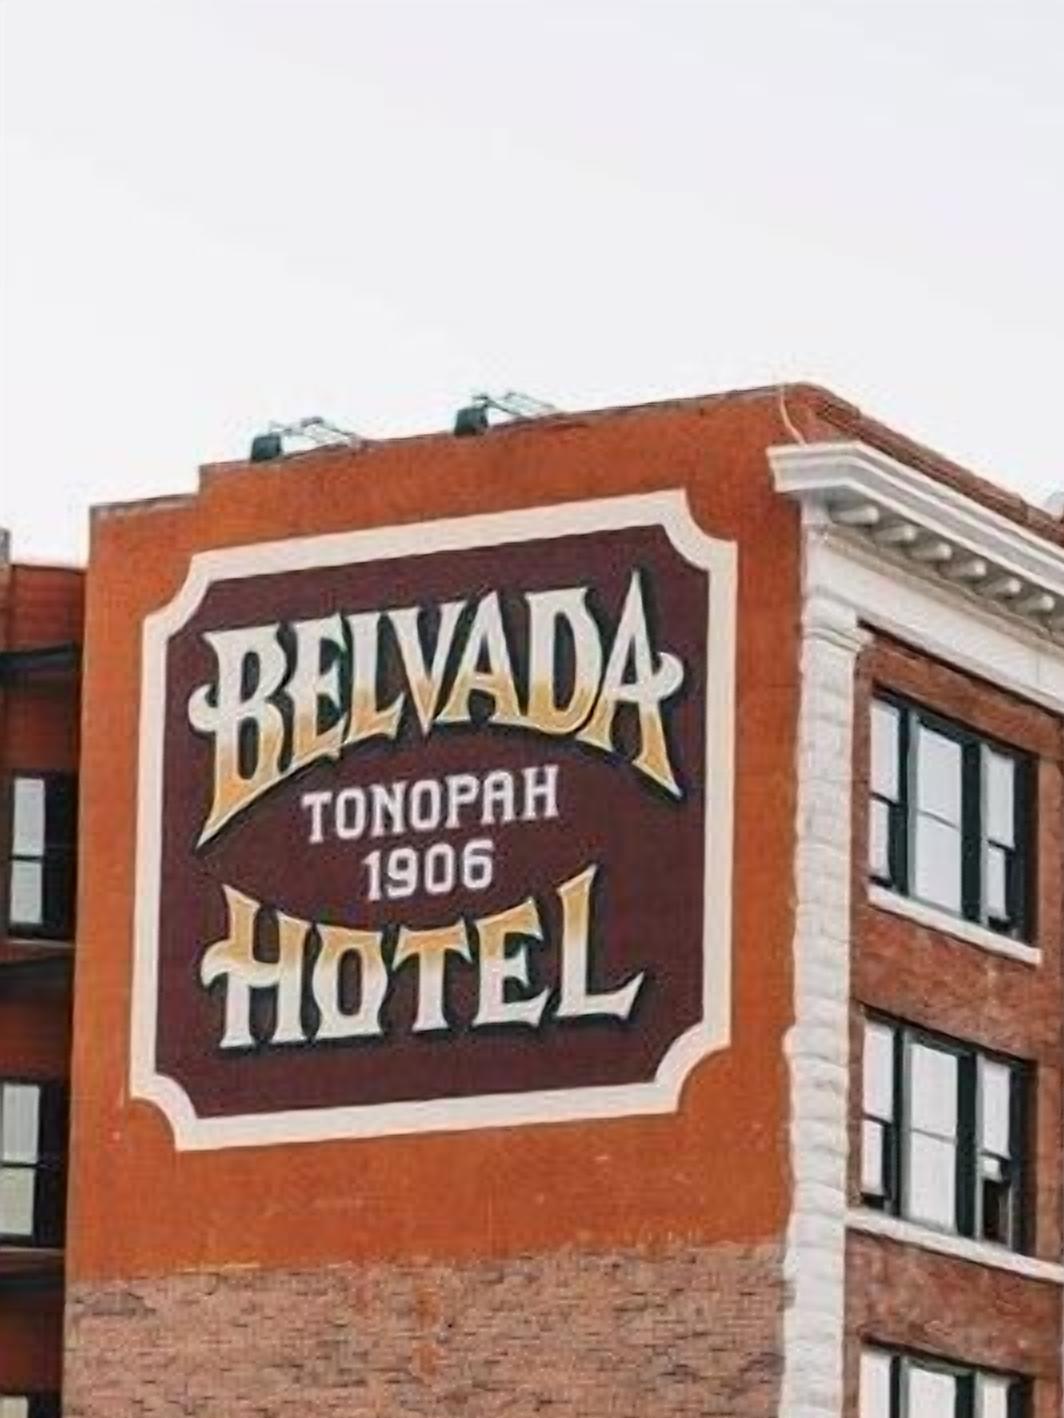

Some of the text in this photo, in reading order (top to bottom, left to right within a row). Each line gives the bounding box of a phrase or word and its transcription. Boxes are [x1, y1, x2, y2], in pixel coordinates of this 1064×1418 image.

[187, 564, 684, 849] BELVADA
[302, 764, 560, 844] TONOPAH
[364, 839, 494, 900] 1906
[201, 863, 645, 1049] HOTEL
